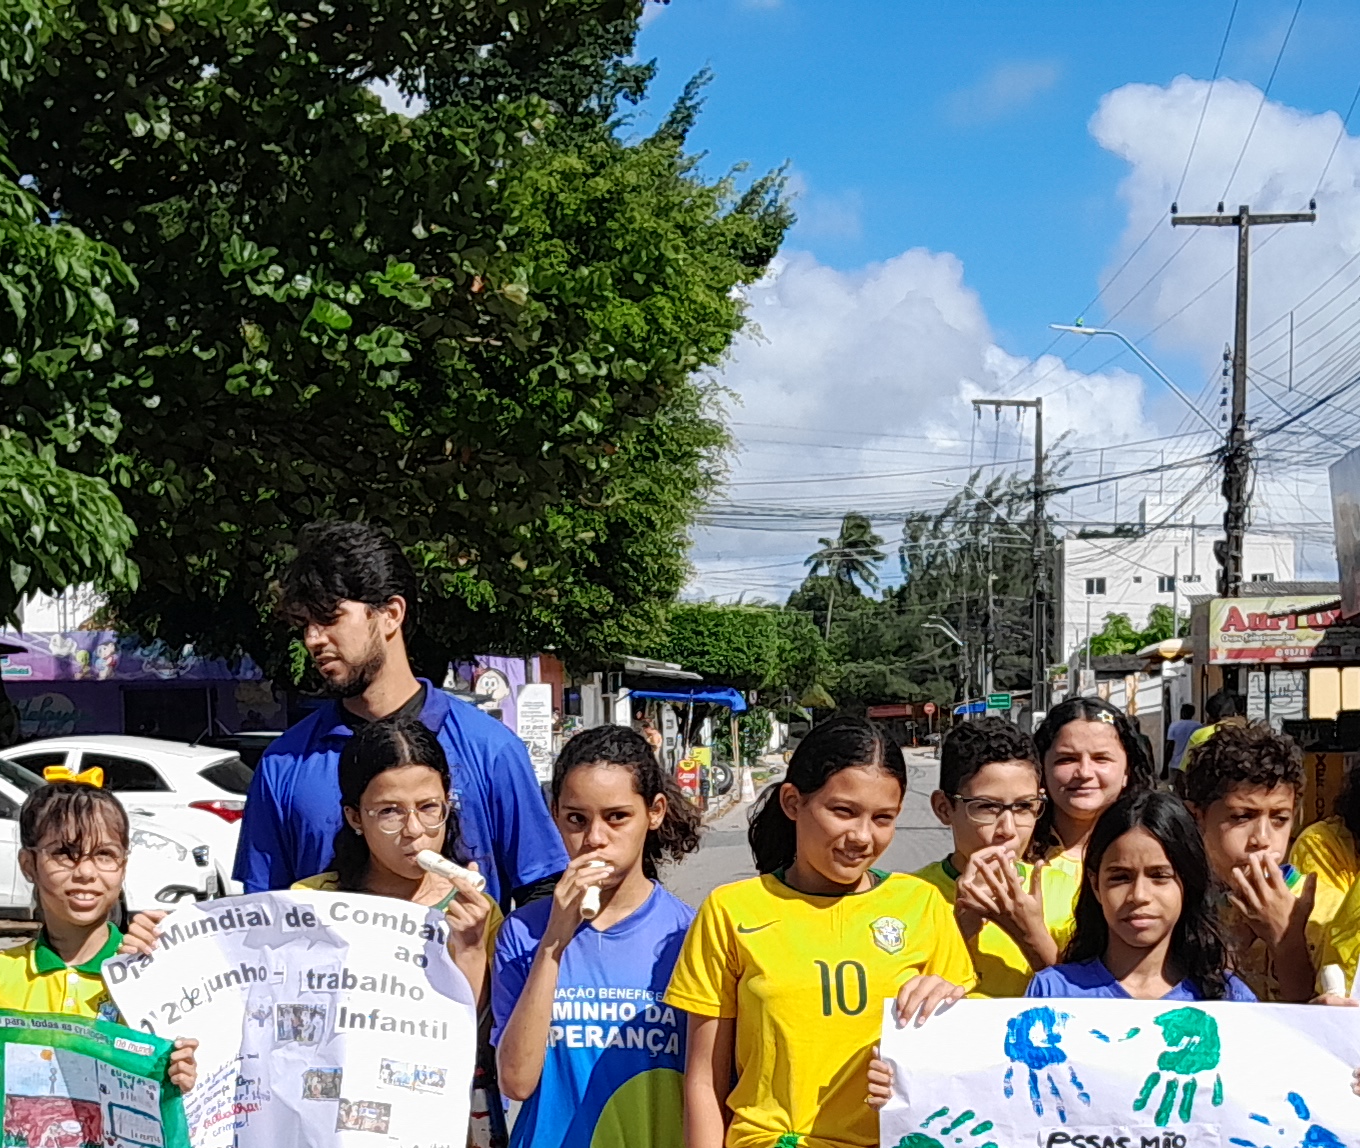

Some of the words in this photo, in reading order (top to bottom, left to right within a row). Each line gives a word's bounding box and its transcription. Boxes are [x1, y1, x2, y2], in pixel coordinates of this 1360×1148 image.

[158, 903, 272, 950] Mundial
[285, 907, 316, 928] de
[329, 902, 446, 946] Combat
[394, 946, 429, 969] ao
[201, 962, 268, 1003] junho
[306, 967, 425, 1001] trabalho
[598, 988, 664, 1003] BENEFICE
[814, 960, 867, 1016] 10
[338, 1006, 448, 1041] Infantil
[551, 1001, 637, 1022] MINHO
[644, 1003, 677, 1028] DA
[546, 1024, 679, 1058] PERANÇA
